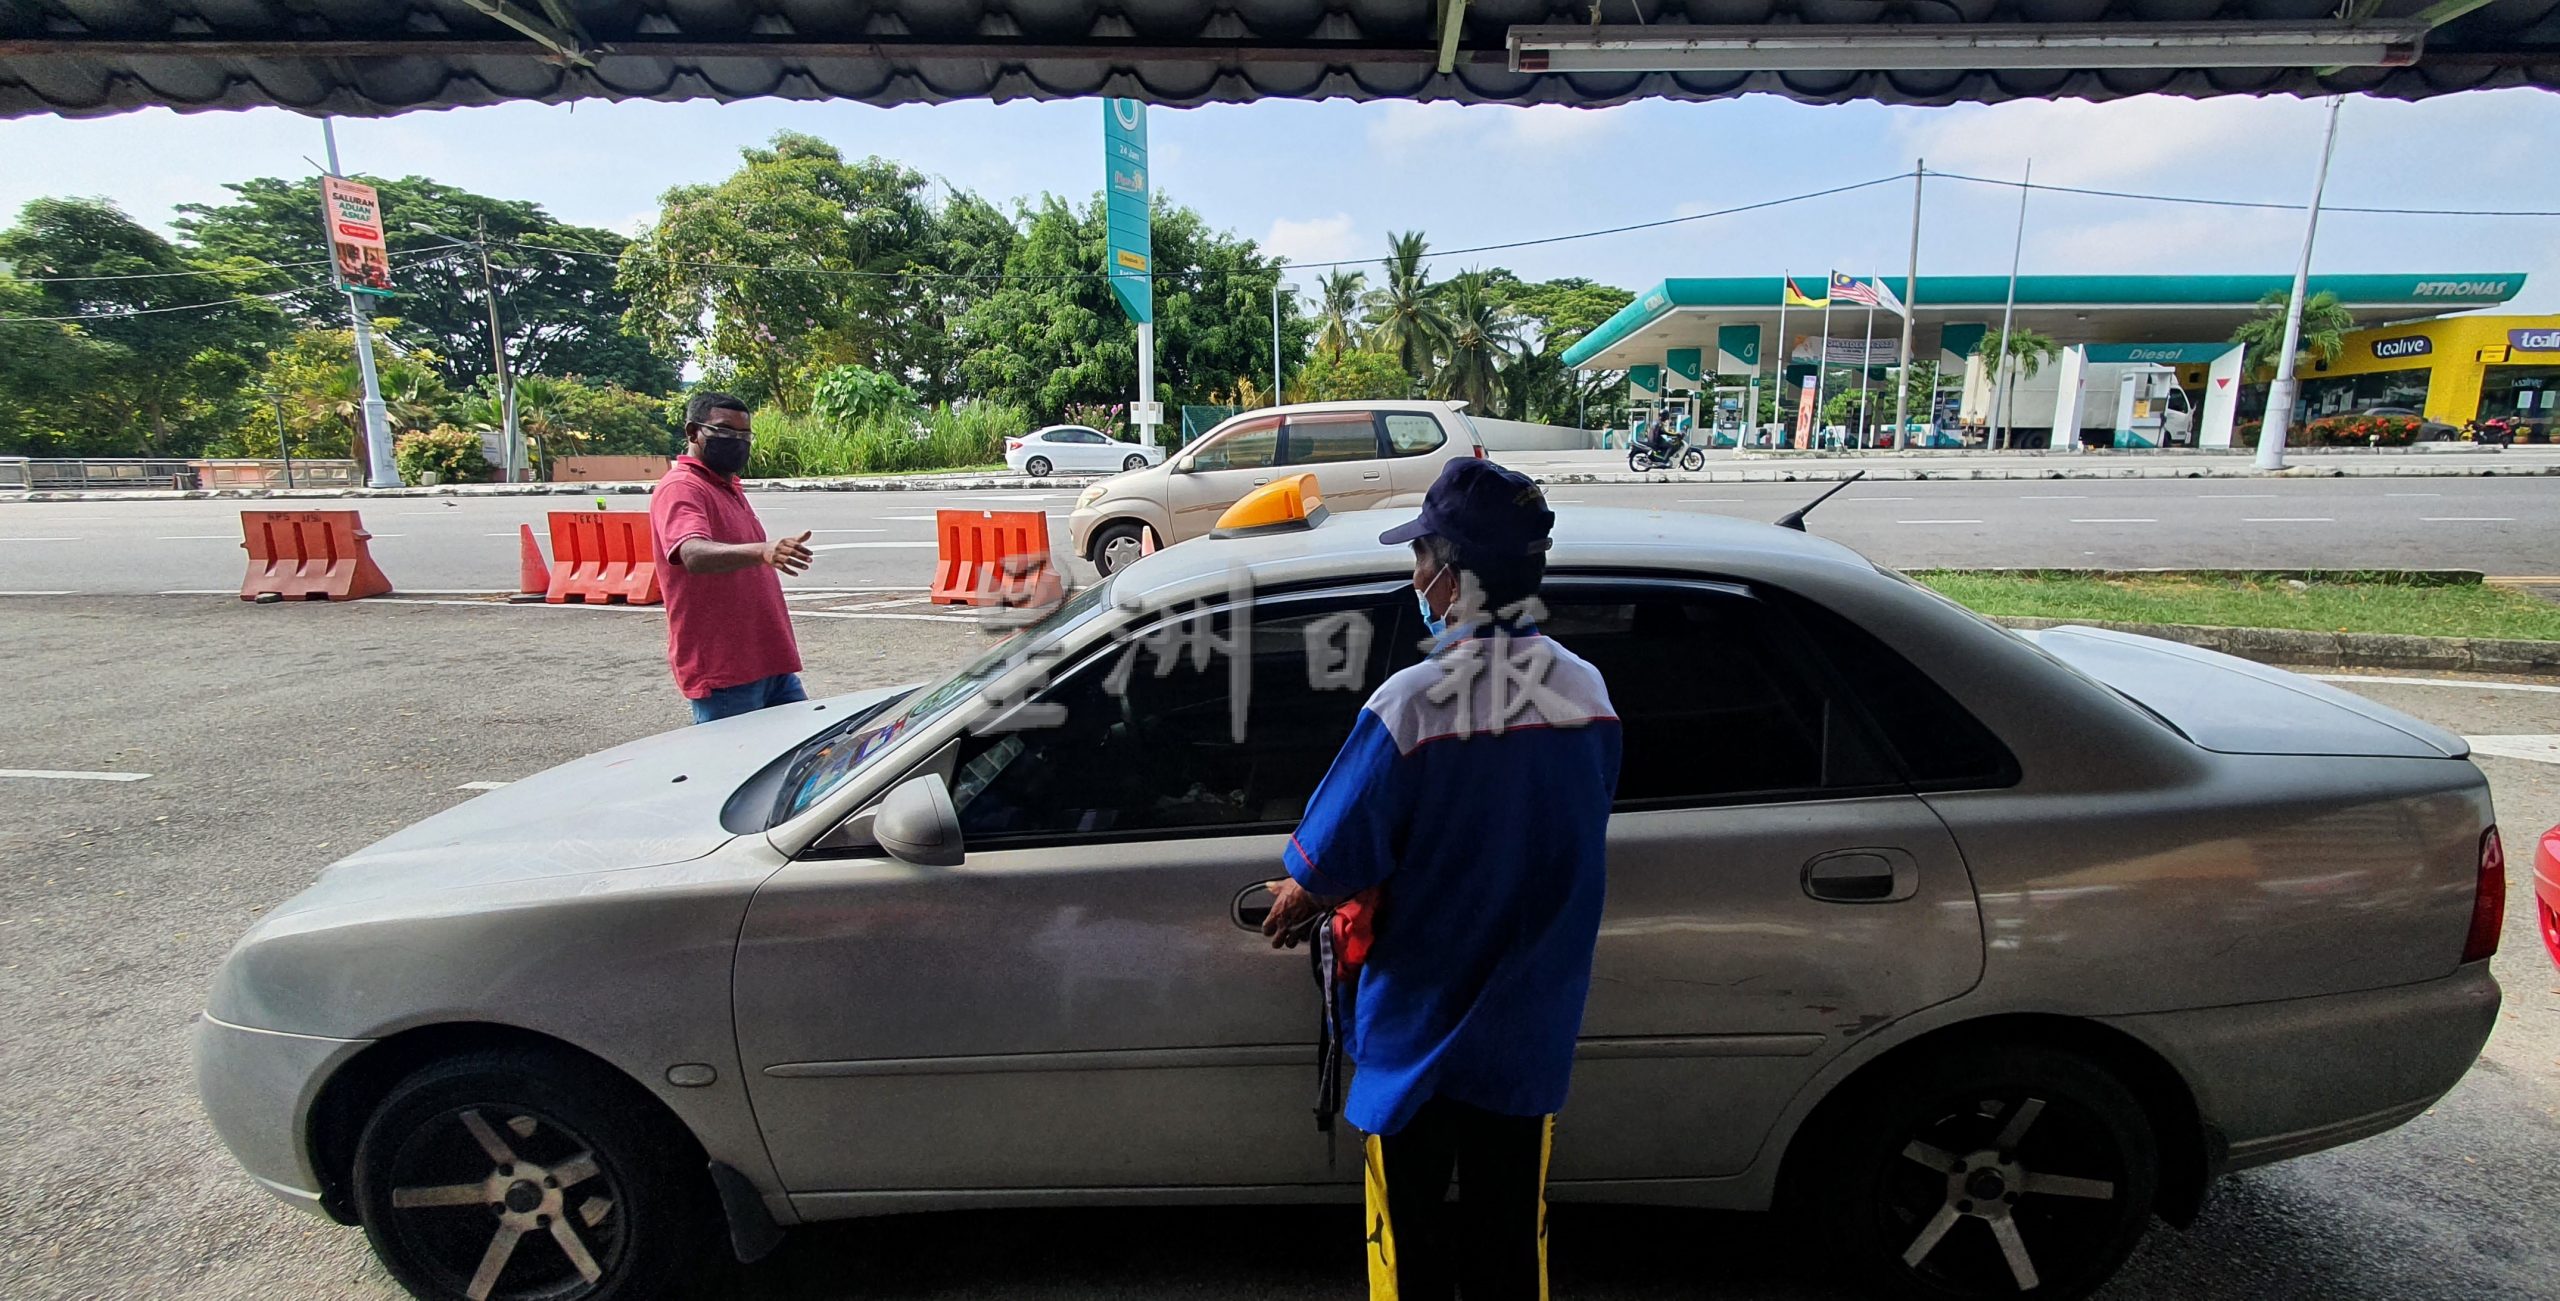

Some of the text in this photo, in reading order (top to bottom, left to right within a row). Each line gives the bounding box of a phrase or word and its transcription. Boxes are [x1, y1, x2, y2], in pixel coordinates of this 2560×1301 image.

[333, 192, 374, 207] SALURAN
[340, 202, 370, 214] ADUAN
[342, 211, 370, 221] ASNAF
[2413, 282, 2507, 295] PETRONAS
[2377, 339, 2424, 356] tealive
[2128, 348, 2183, 360] Diesel
